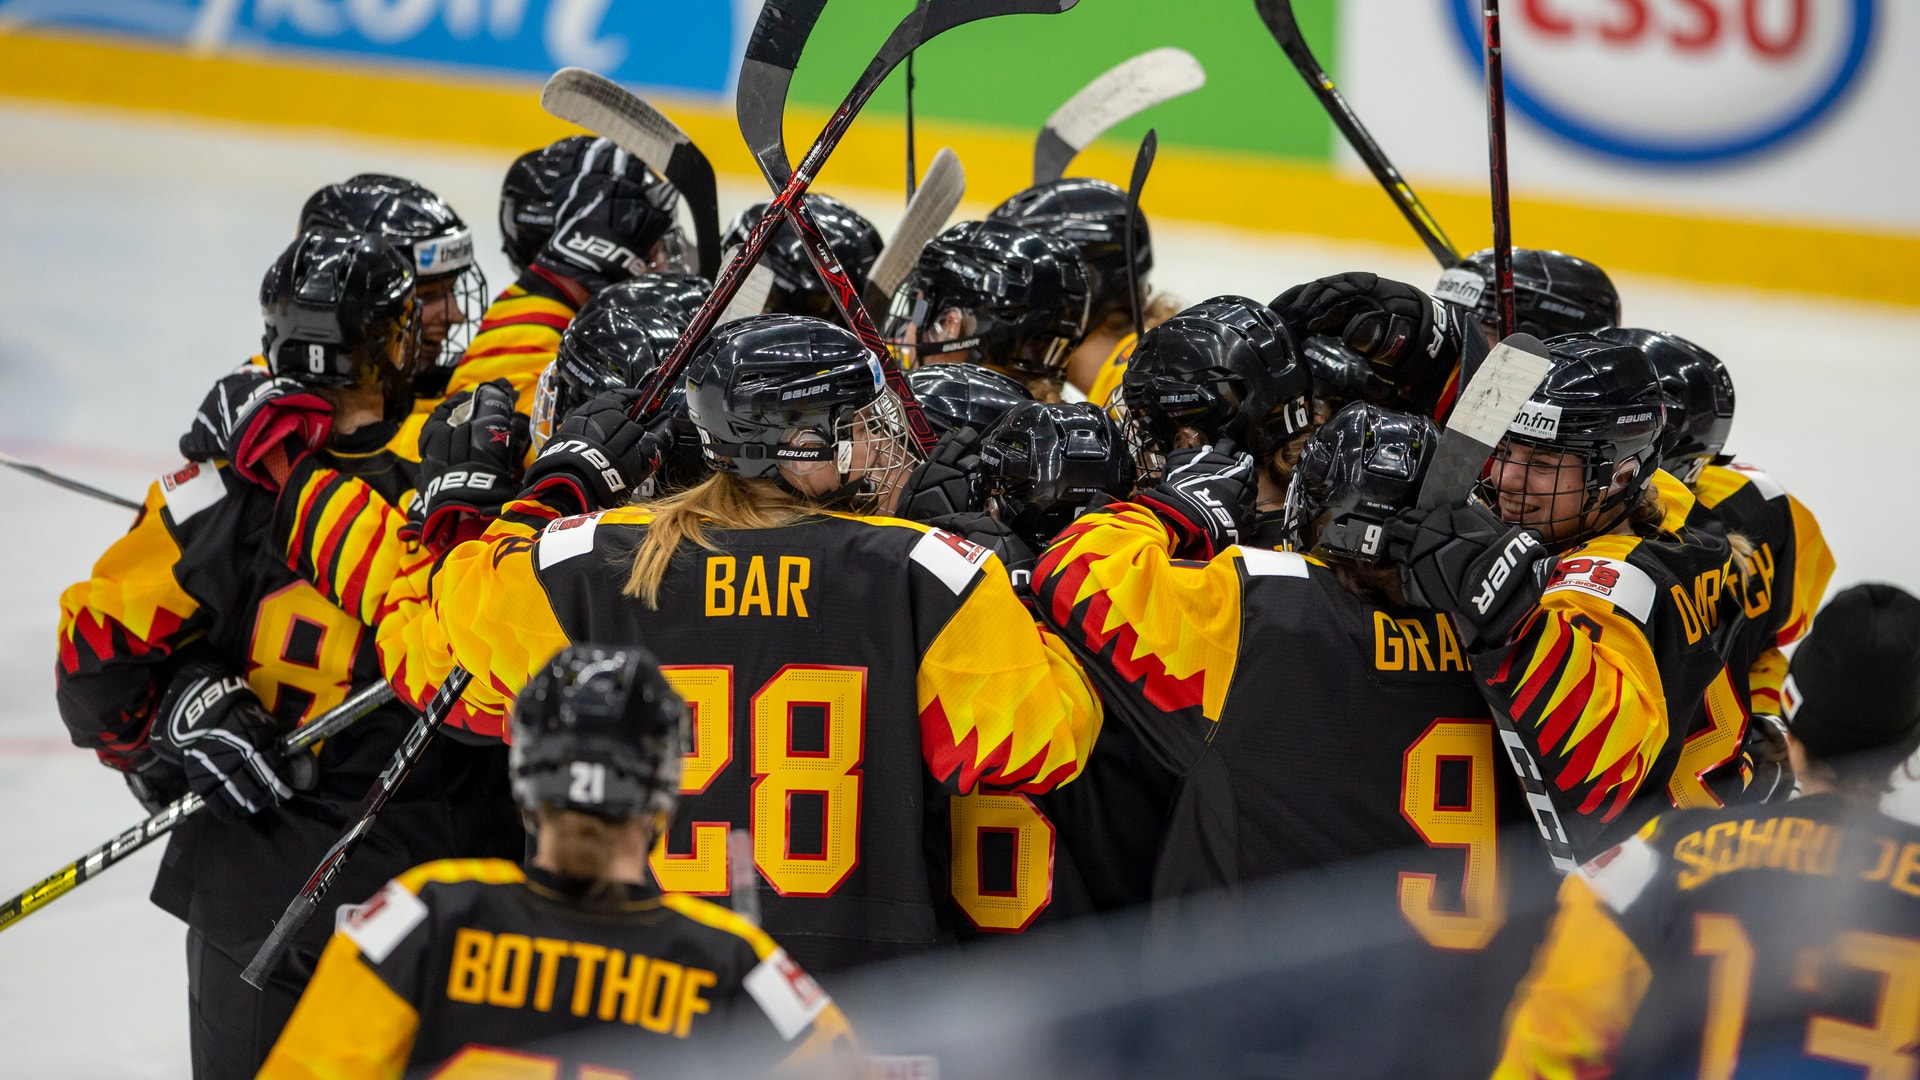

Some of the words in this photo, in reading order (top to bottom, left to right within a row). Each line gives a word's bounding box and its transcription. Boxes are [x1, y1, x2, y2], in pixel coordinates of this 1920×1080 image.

[566, 230, 649, 278] AUER
[308, 344, 325, 374] 8
[781, 382, 831, 401] BAUER
[1283, 395, 1309, 435] 16
[1616, 411, 1653, 425] BAUER
[777, 449, 819, 459] BAUER
[1361, 524, 1383, 556] 9
[704, 555, 812, 618] BAR
[1471, 531, 1541, 616] AUER
[1373, 610, 1472, 672] GRA
[245, 578, 366, 758] 8
[185, 676, 252, 730] BAU
[569, 760, 605, 804] 21
[647, 663, 869, 898] 28
[1396, 717, 1507, 951] 9
[446, 927, 718, 1039] BOTTHOF
